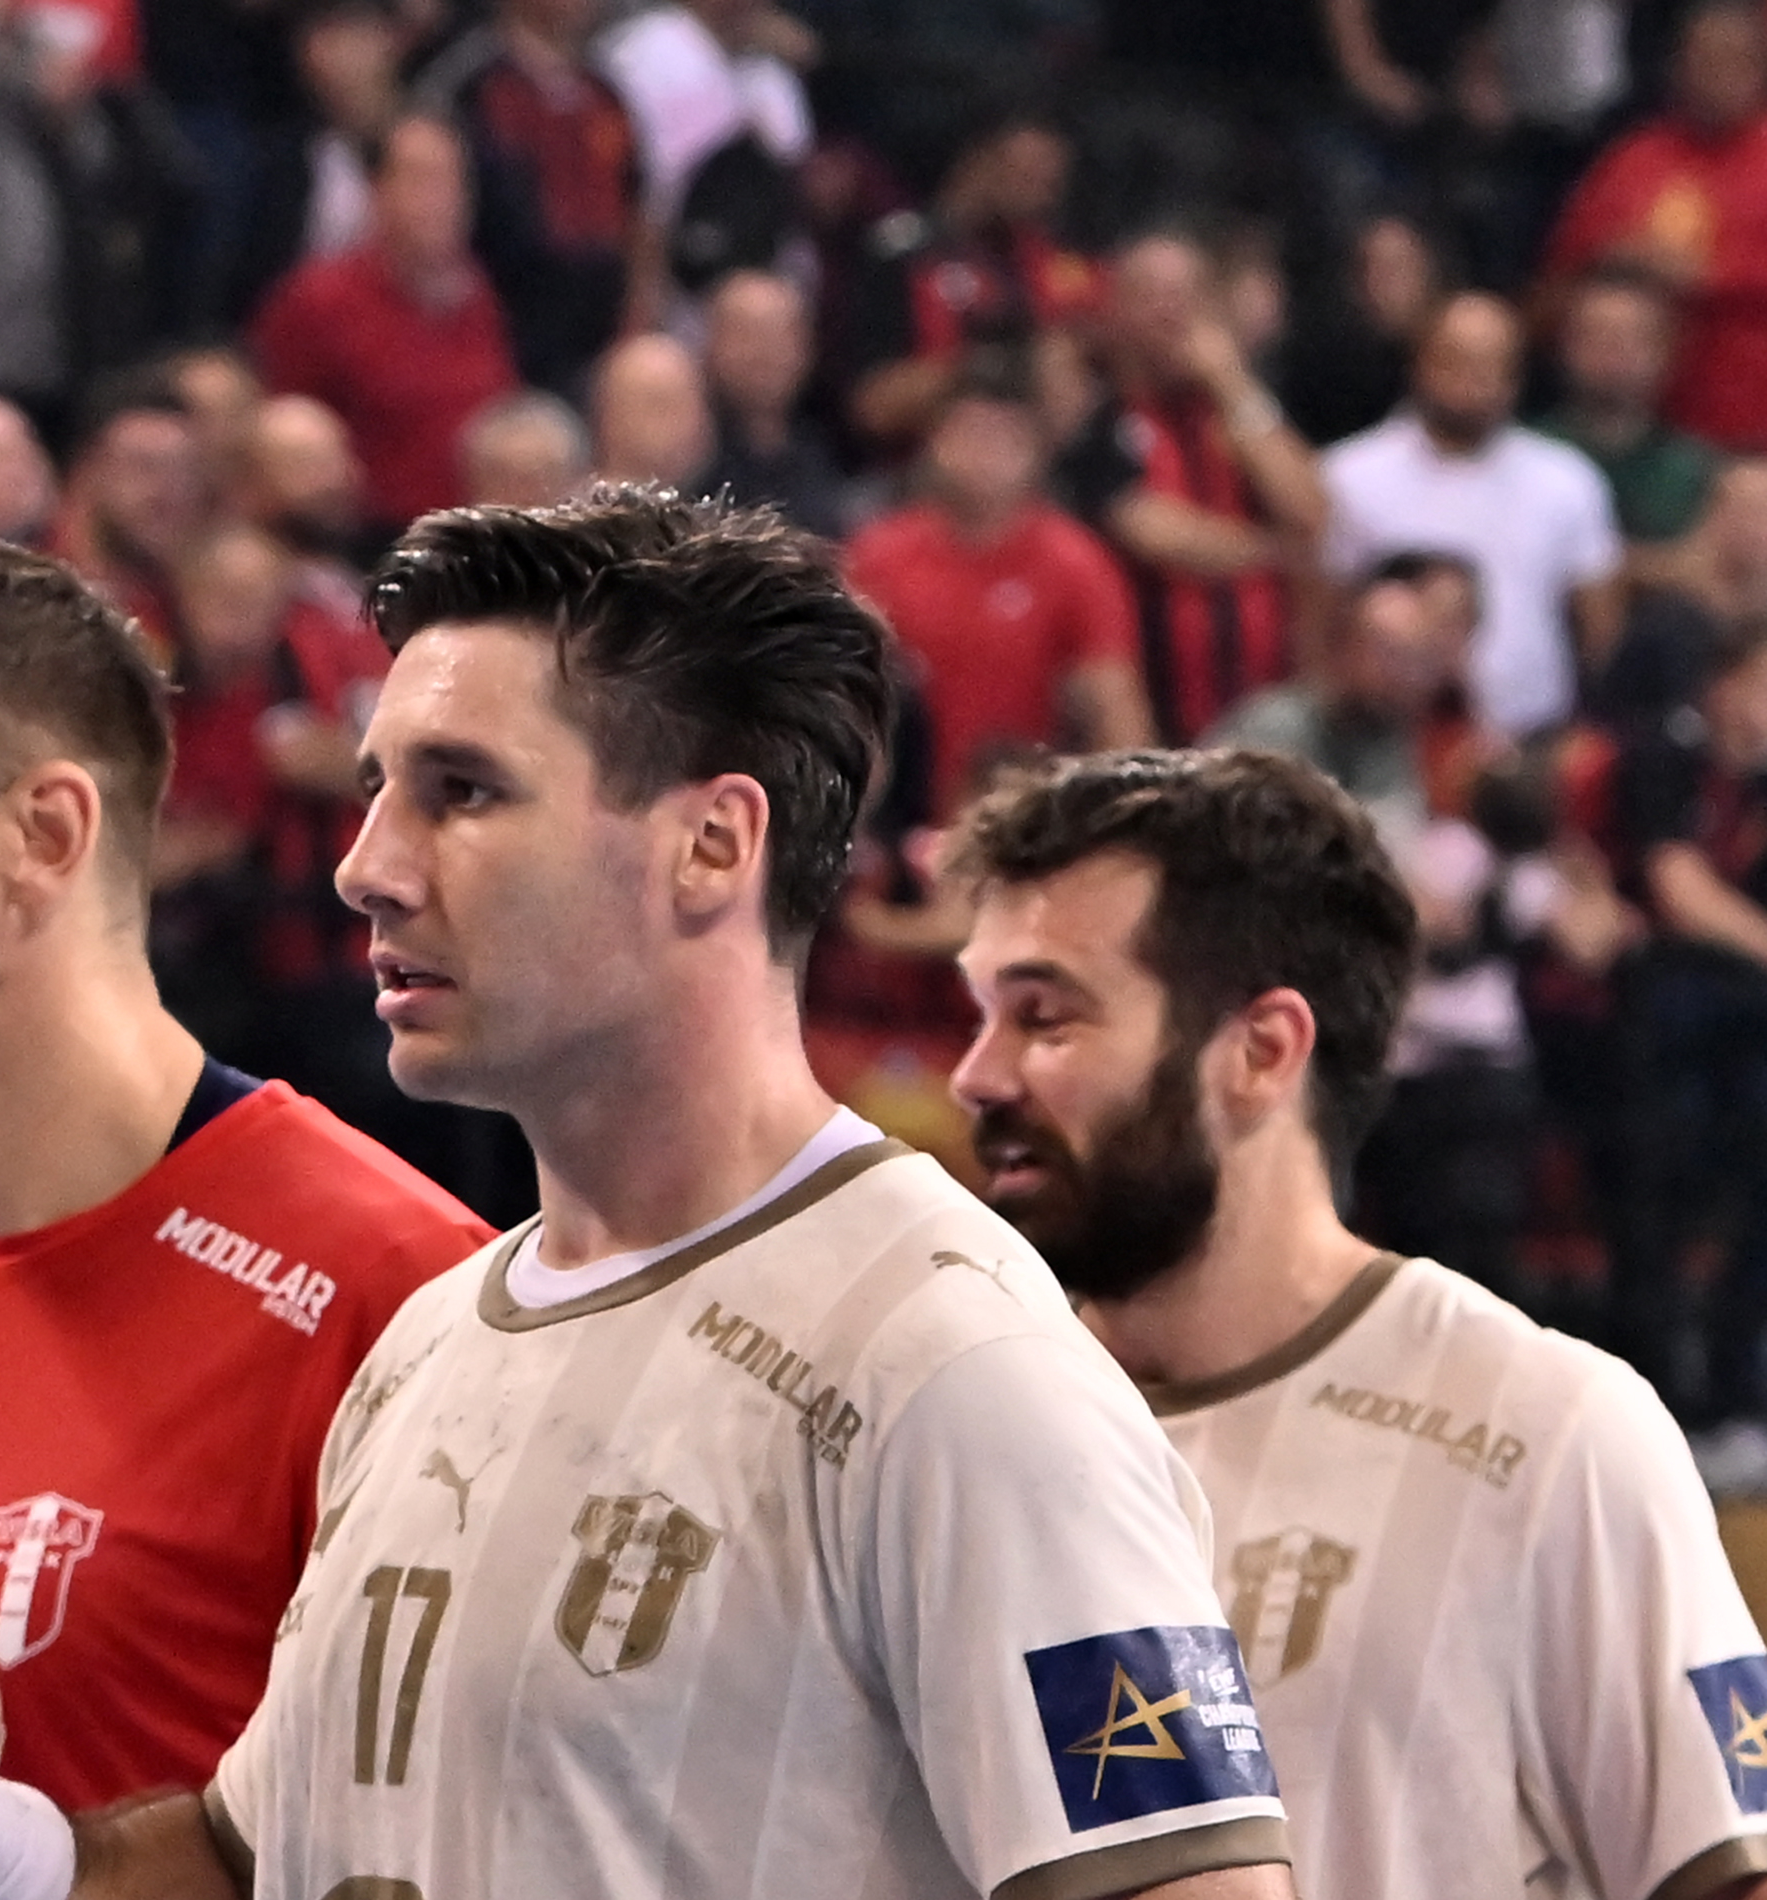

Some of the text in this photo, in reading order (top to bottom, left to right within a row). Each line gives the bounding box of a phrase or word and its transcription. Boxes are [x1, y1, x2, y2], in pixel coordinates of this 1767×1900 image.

[154, 1206, 337, 1319] MODULAR
[687, 1301, 863, 1454] MODULAR
[1309, 1383, 1527, 1477] MODULAR
[354, 1565, 452, 1786] 17
